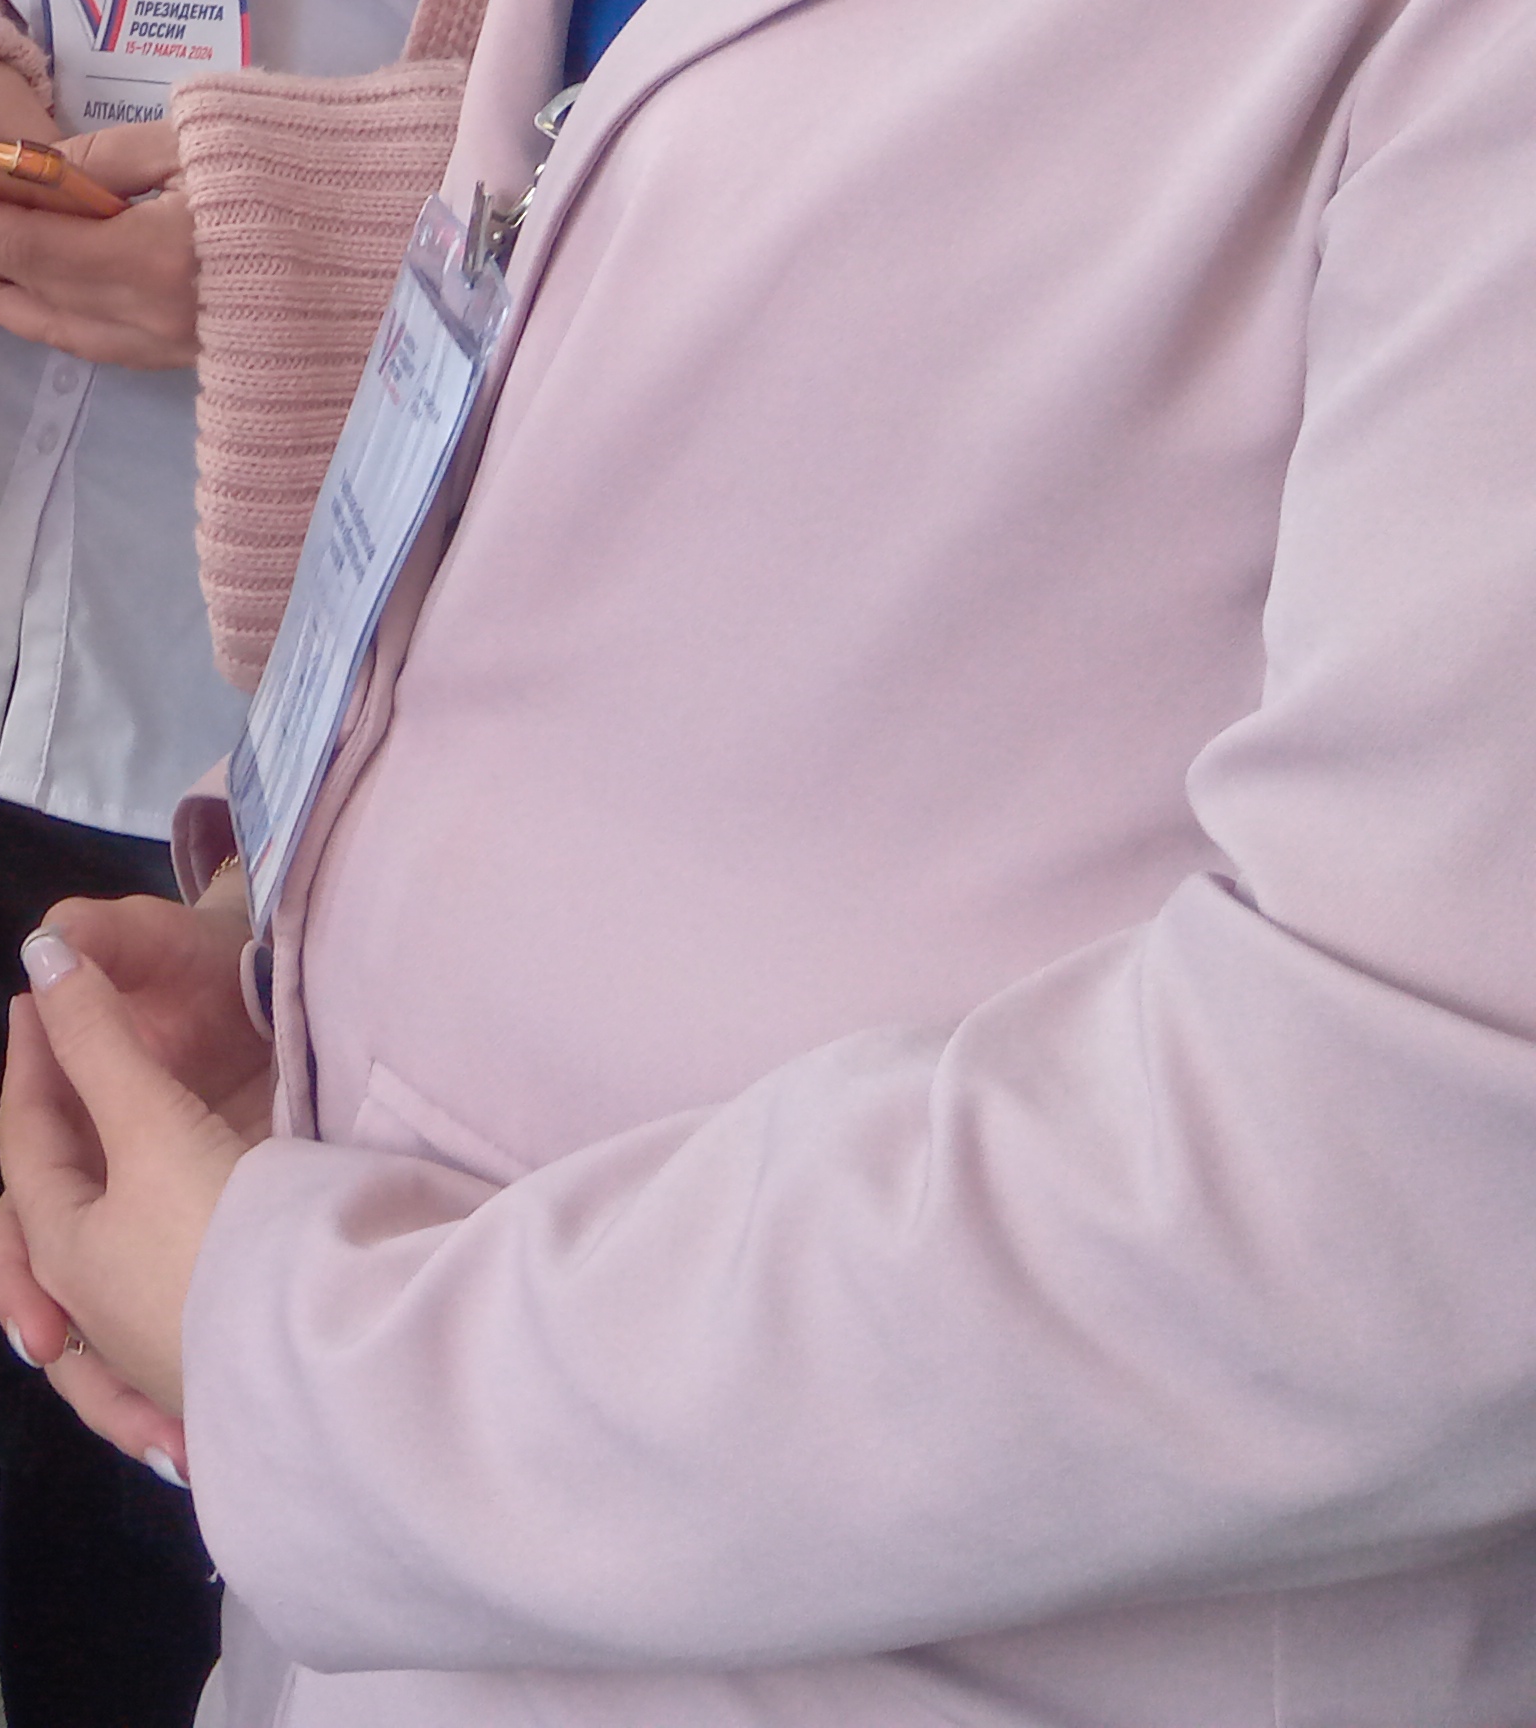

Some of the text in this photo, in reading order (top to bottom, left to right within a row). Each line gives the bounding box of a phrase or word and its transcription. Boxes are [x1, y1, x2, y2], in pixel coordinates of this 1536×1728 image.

[134, 1, 224, 21] ПРЕЗИДЕНТА
[129, 21, 186, 39] РОССИИ
[153, 42, 186, 58] МАРТА
[188, 45, 213, 60] 2024
[83, 99, 164, 123] АЛТАЙСКИЙ
